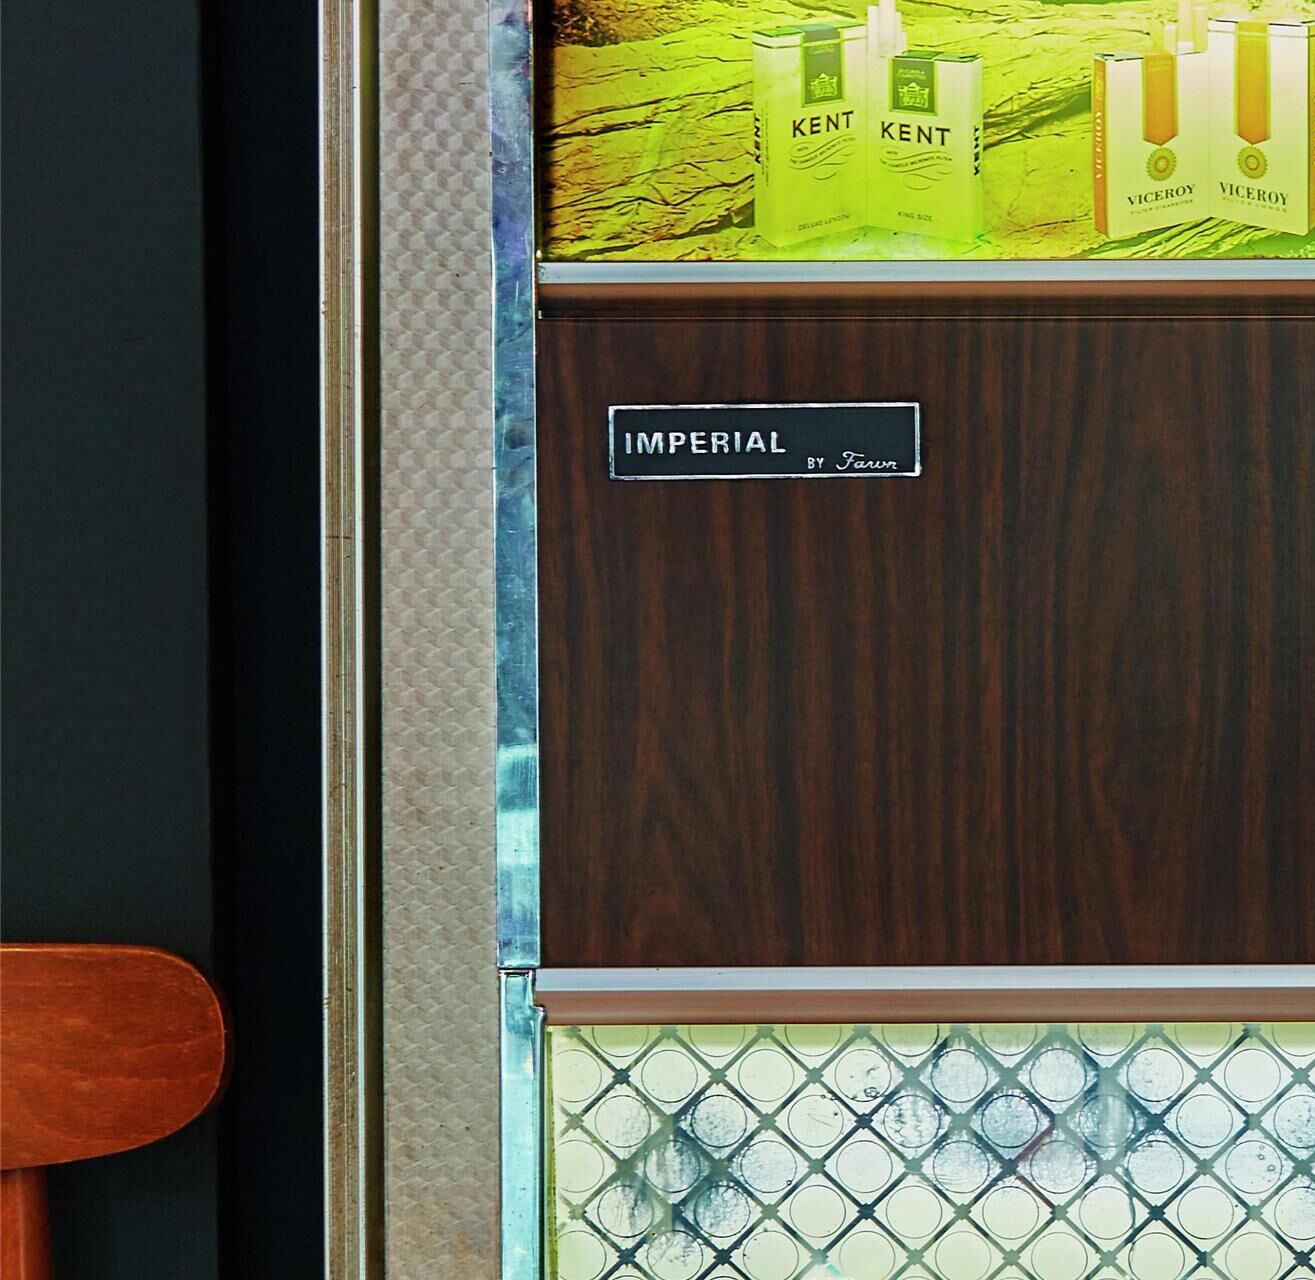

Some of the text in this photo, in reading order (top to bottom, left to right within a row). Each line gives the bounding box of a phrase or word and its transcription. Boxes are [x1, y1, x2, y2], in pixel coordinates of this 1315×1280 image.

[792, 110, 854, 138] KENT
[881, 121, 950, 146] KENT
[1127, 184, 1195, 205] VICEROY
[1219, 182, 1289, 206] VICEROY
[624, 431, 786, 455] IMPERIAL
[807, 450, 898, 471] BY Fawn
